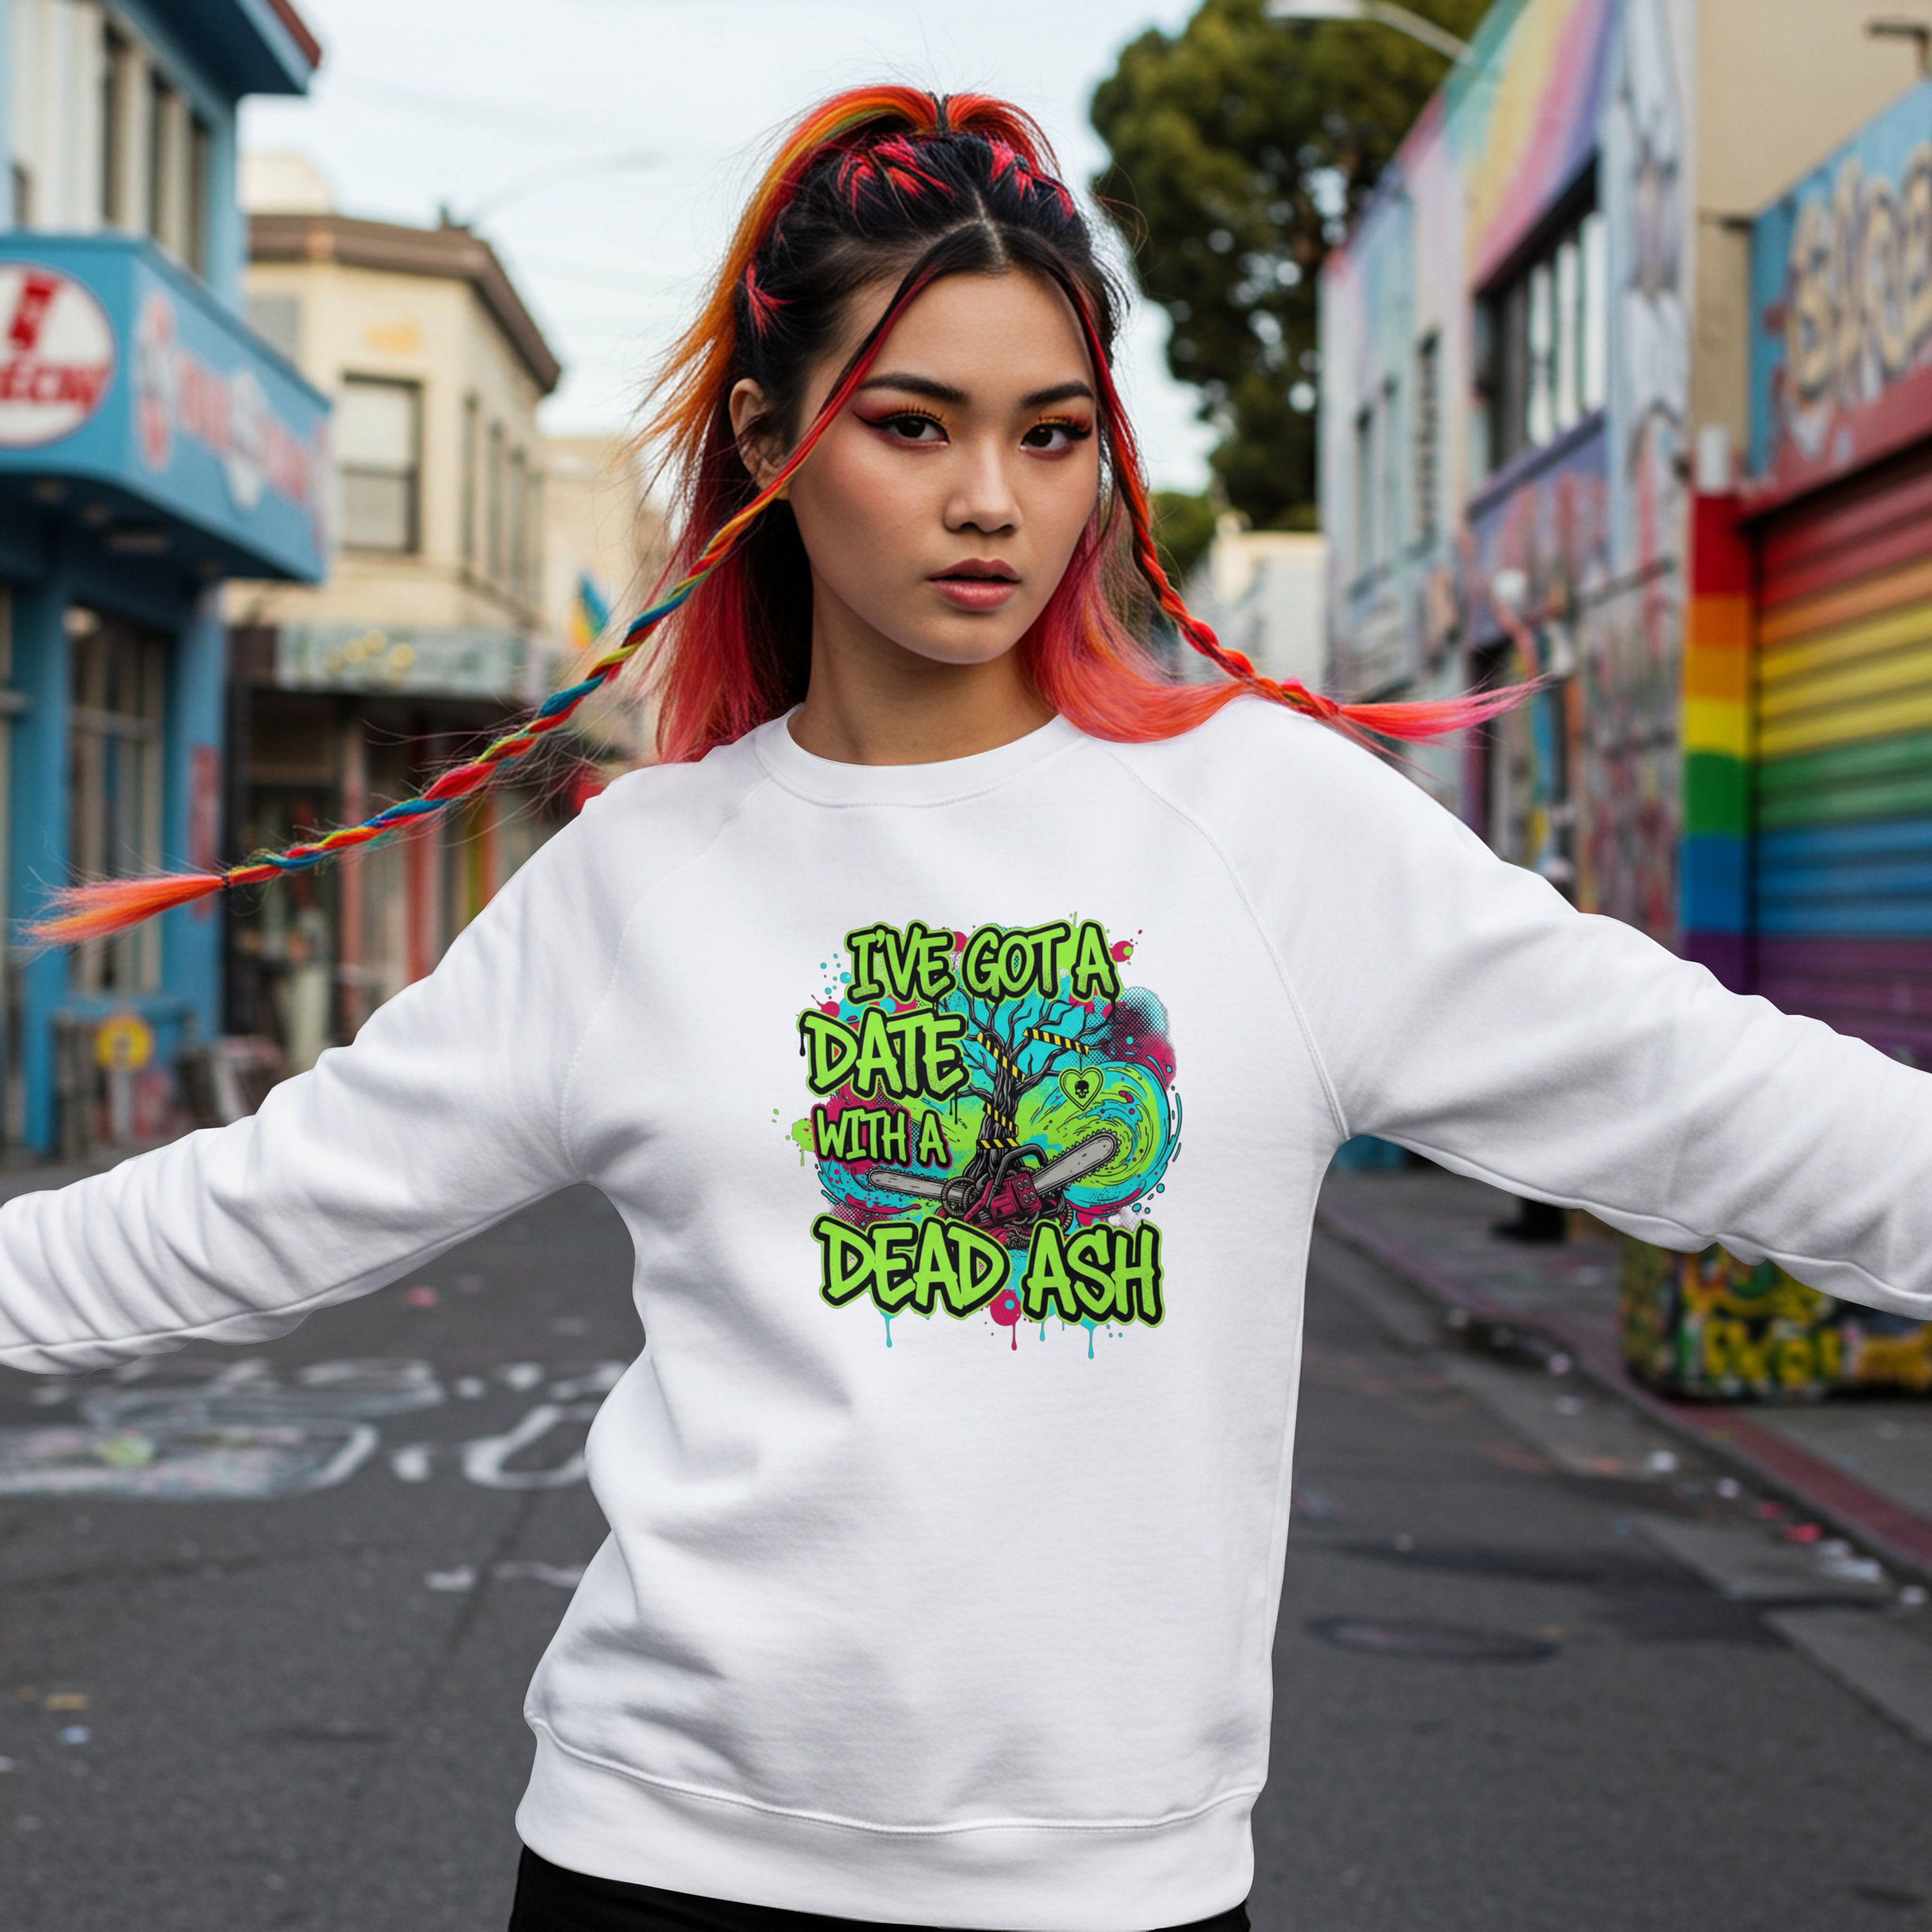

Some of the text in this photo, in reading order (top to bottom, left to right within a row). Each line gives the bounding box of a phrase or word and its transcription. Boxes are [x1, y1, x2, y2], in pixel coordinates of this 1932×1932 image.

[963, 922, 1070, 1002] GOT
[1071, 921, 1121, 1001] A
[799, 1009, 969, 1099] DATE
[813, 1106, 951, 1166] WITH A
[814, 1217, 1164, 1325] DEAD ASH
